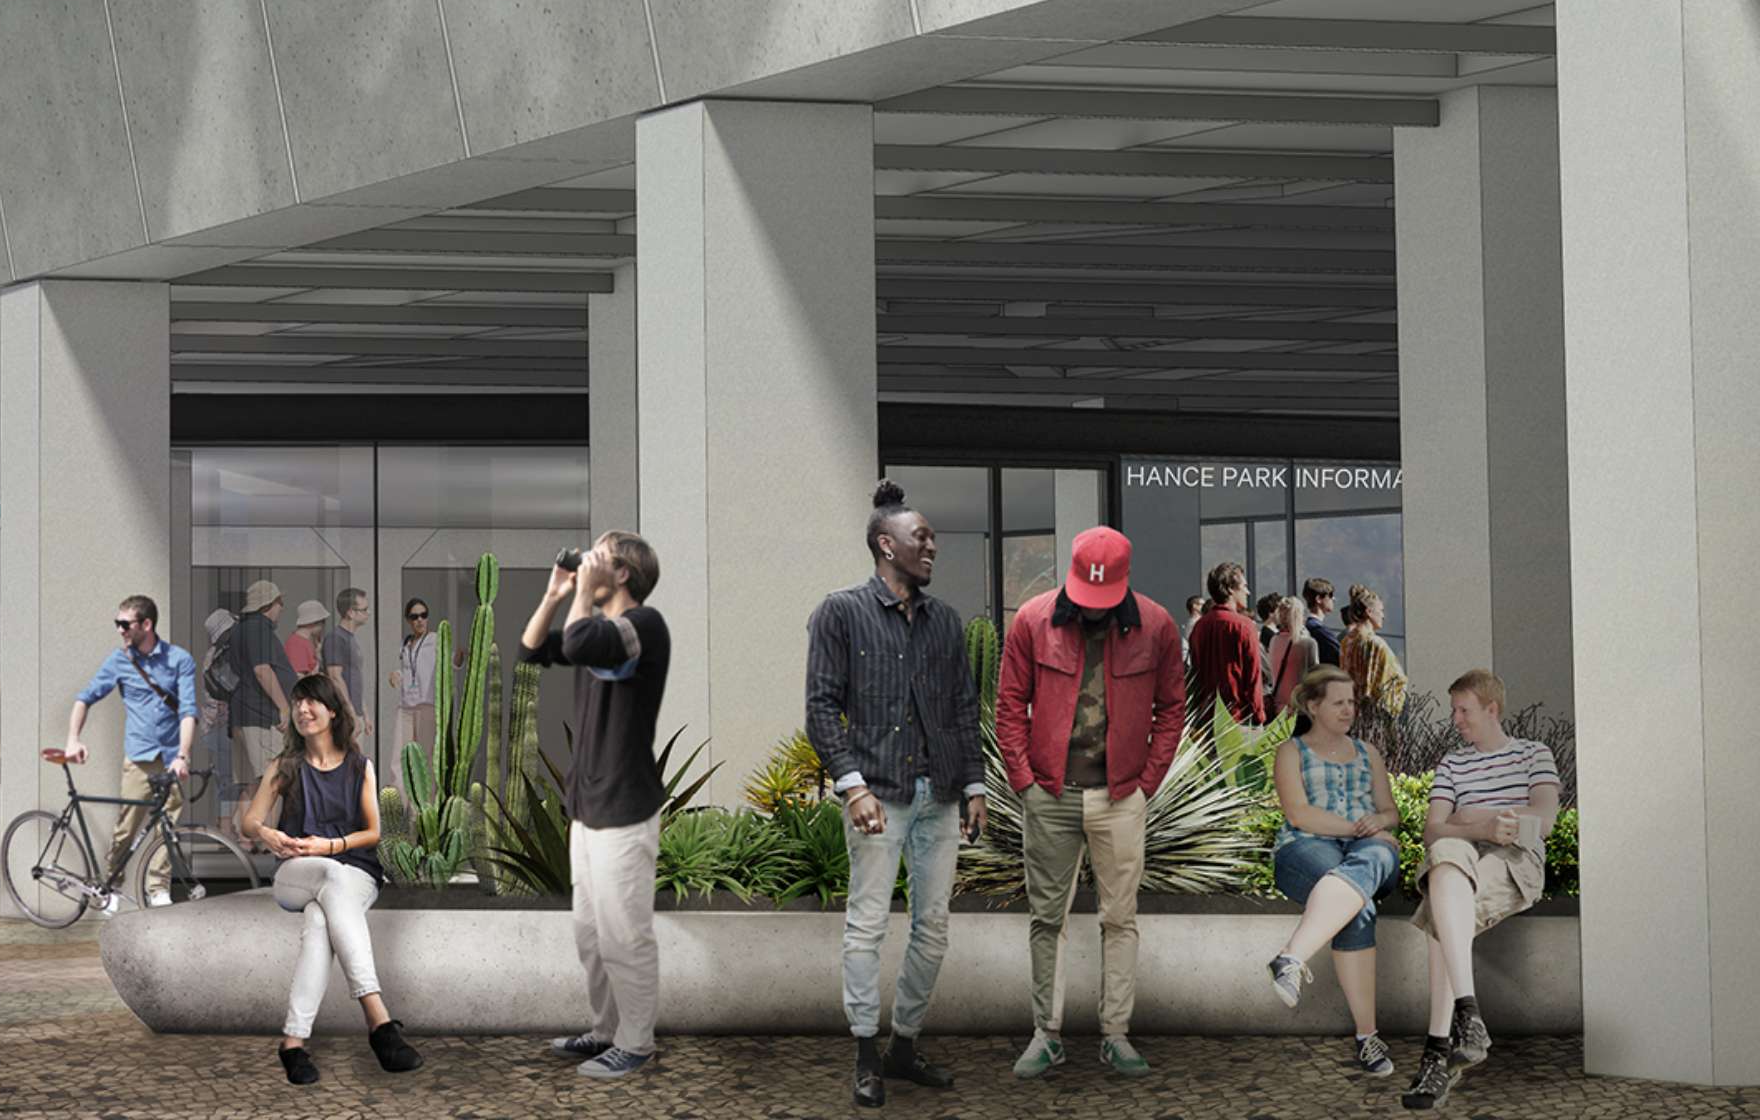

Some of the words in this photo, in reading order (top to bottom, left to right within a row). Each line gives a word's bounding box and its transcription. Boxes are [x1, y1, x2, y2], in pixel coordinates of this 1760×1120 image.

[1127, 465, 1216, 488] HANCE
[1222, 466, 1288, 489] PARK
[1090, 562, 1105, 582] H
